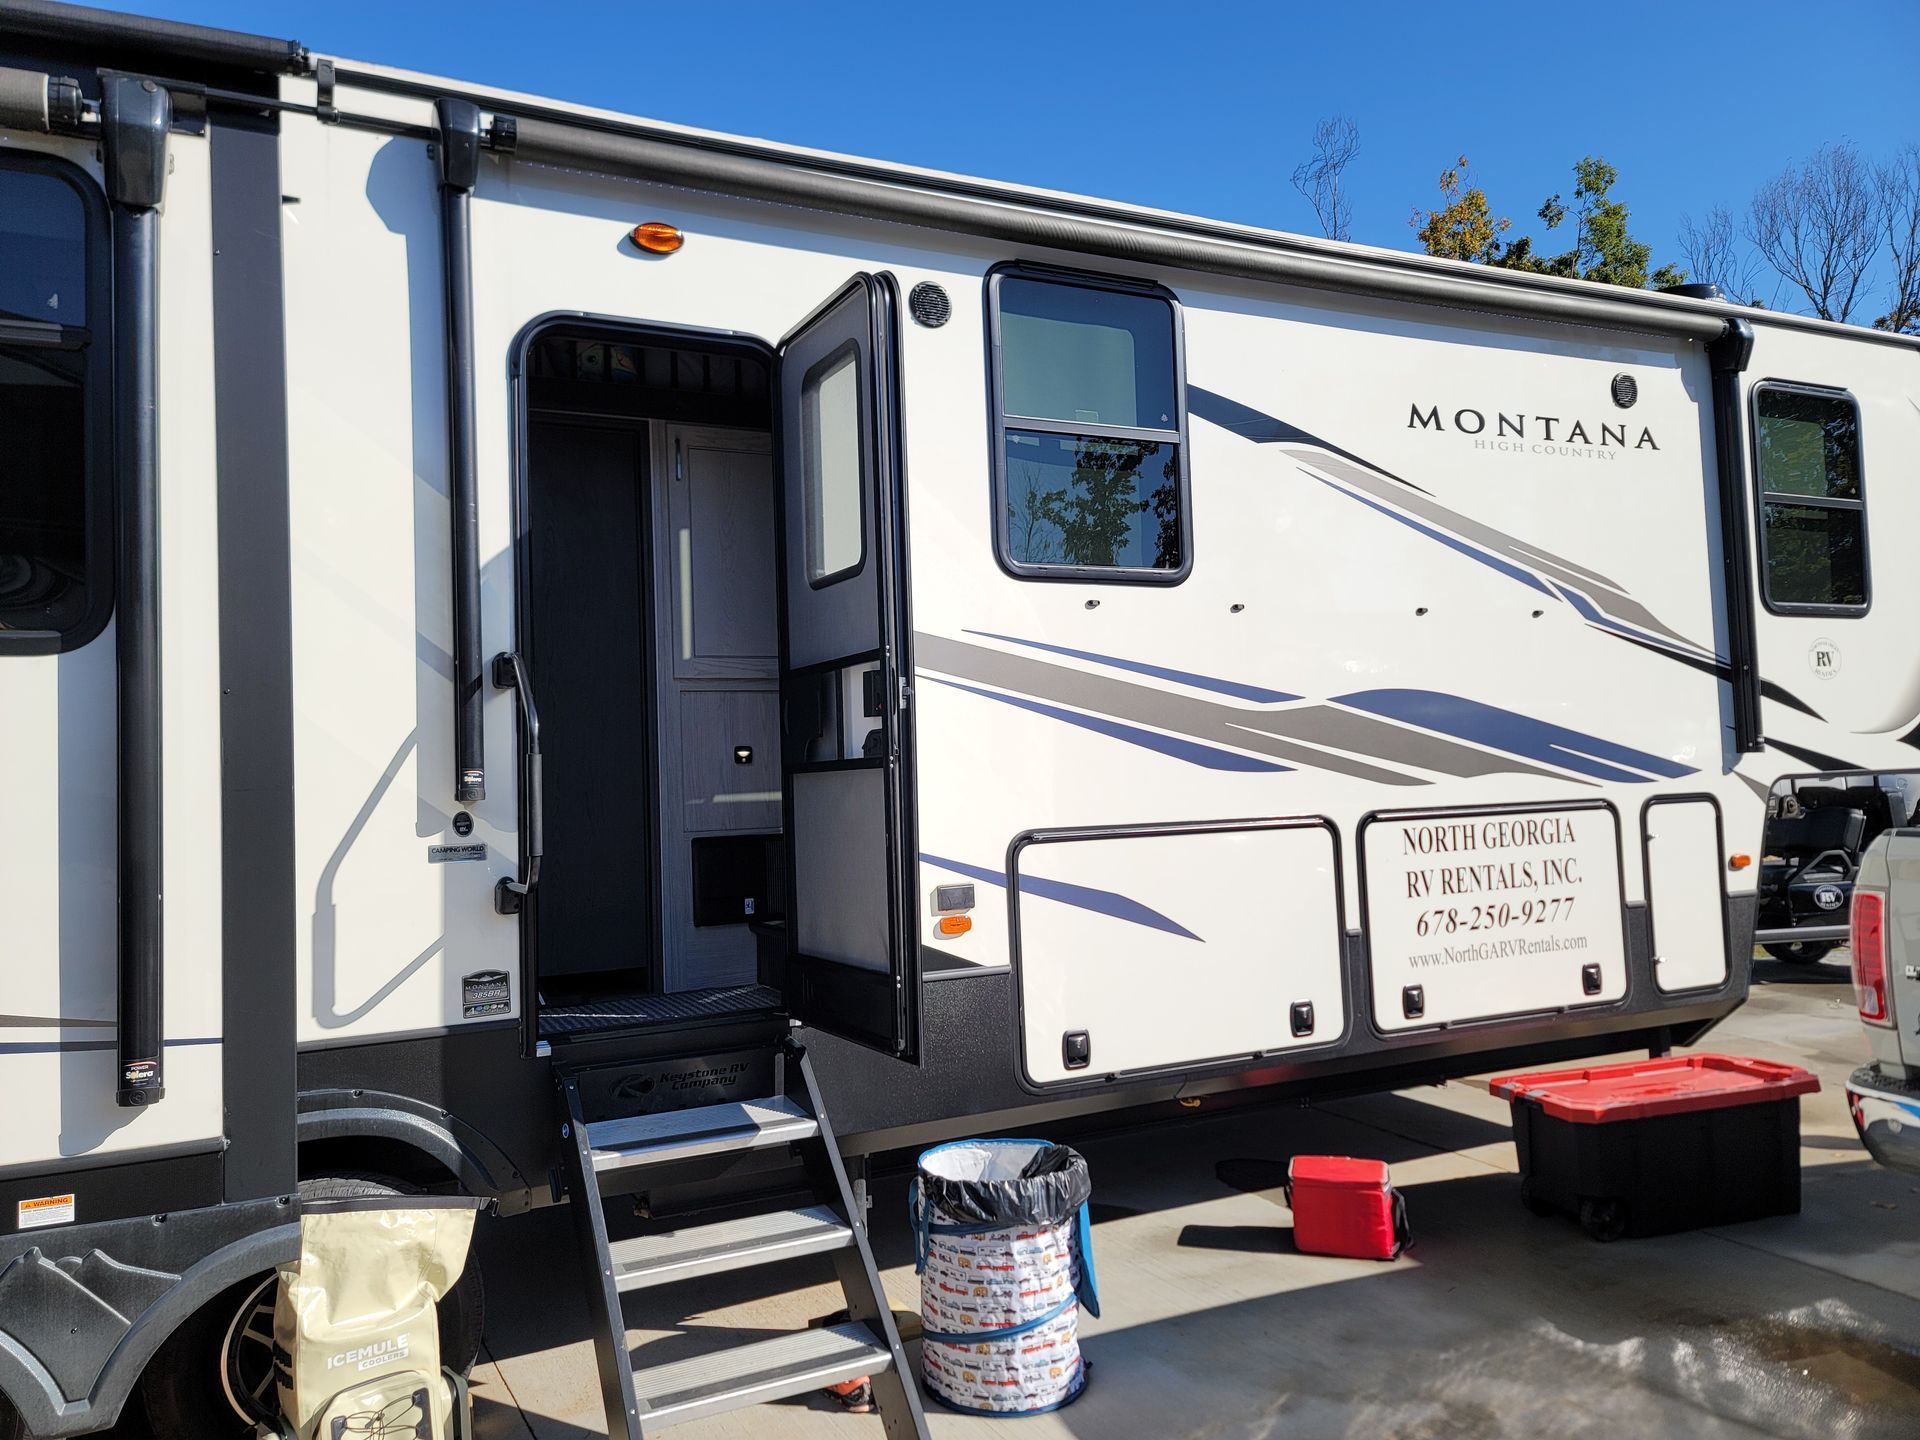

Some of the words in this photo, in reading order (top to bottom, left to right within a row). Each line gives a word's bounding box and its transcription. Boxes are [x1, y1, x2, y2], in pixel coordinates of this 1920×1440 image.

[1407, 402, 1661, 450] MONTANA
[1474, 439, 1524, 452] HIGH
[1531, 444, 1617, 460] COUNTRY
[1816, 651, 1834, 667] RV
[1402, 823, 1477, 855] NORTH
[1482, 818, 1576, 850] GEORGIA
[431, 846, 461, 854] CAMPING
[461, 844, 485, 852] WORLD
[1405, 869, 1434, 898] RV
[1441, 860, 1539, 895] RENTALS,
[1542, 857, 1583, 886] INC.
[1416, 897, 1576, 937] 678-250-9277
[1408, 935, 1588, 969] www.NorthGARVRentals.com
[465, 981, 507, 991] MONTANA
[125, 1070, 154, 1080] Solera
[660, 1066, 728, 1083] Keystone
[730, 1062, 750, 1073] RV
[672, 1075, 737, 1091] Company
[33, 1197, 68, 1207] WARNING
[327, 1333, 409, 1370] ICEMULE
[362, 1351, 406, 1368] COOLERS
